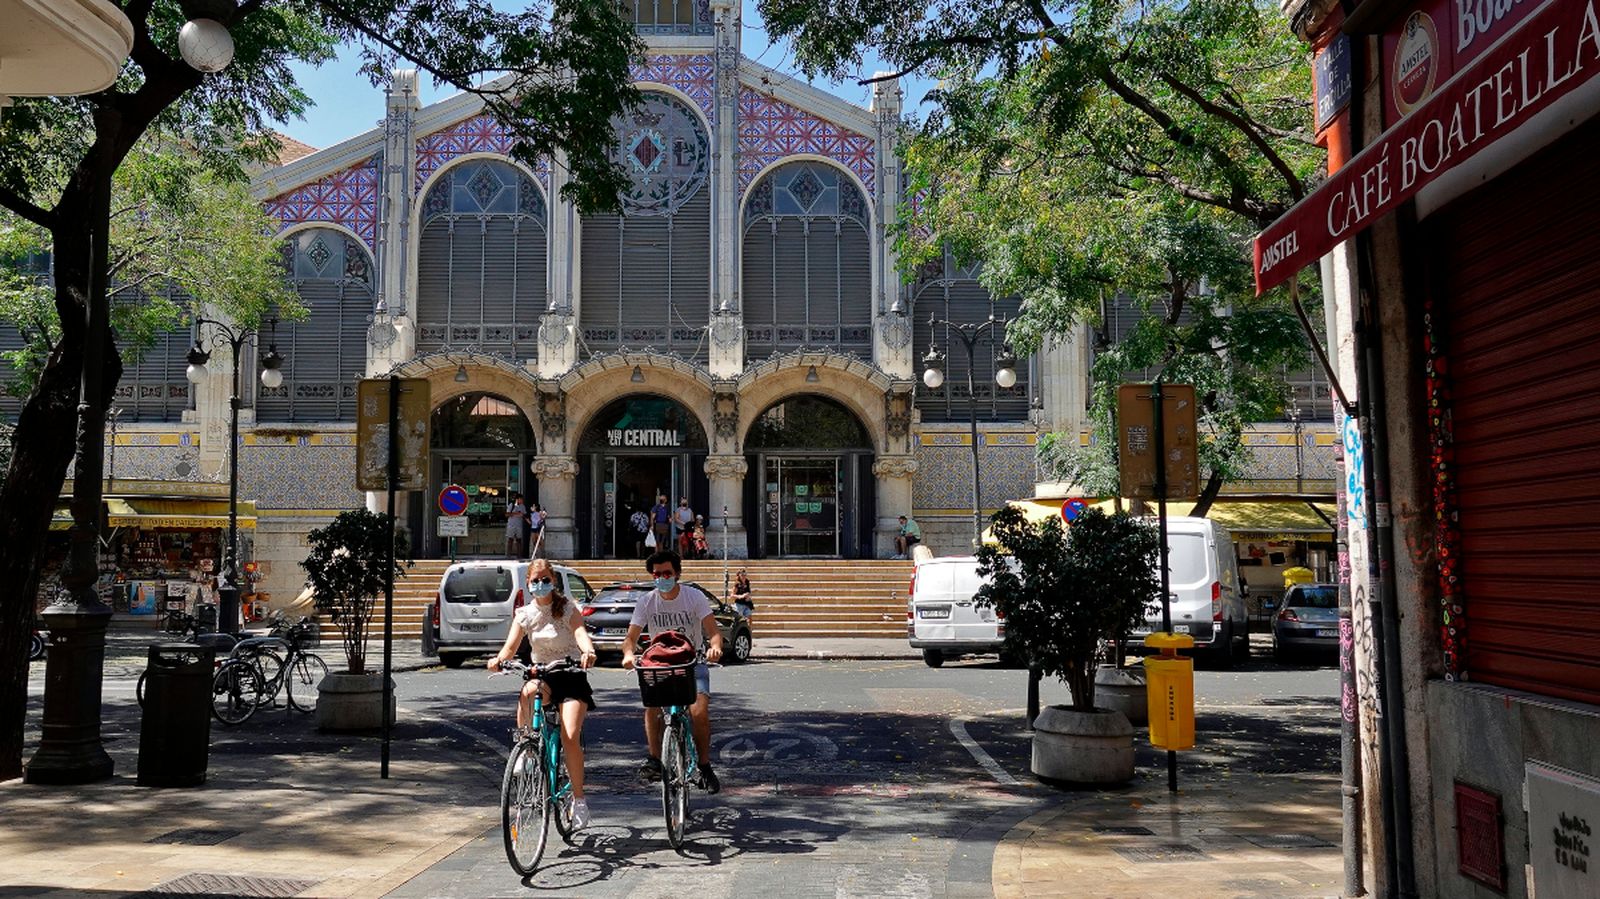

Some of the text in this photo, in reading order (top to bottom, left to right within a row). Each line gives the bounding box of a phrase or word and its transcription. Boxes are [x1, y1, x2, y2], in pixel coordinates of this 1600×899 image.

[1323, 38, 1344, 70] CALLE
[1401, 43, 1429, 76] AMSTEL
[1328, 65, 1338, 83] DE
[1327, 0, 1600, 238] CAFÉ BOATELLA
[1259, 230, 1299, 274] AMSTEL
[624, 429, 680, 446] CENTRAL
[652, 611, 694, 627] NIRVANA
